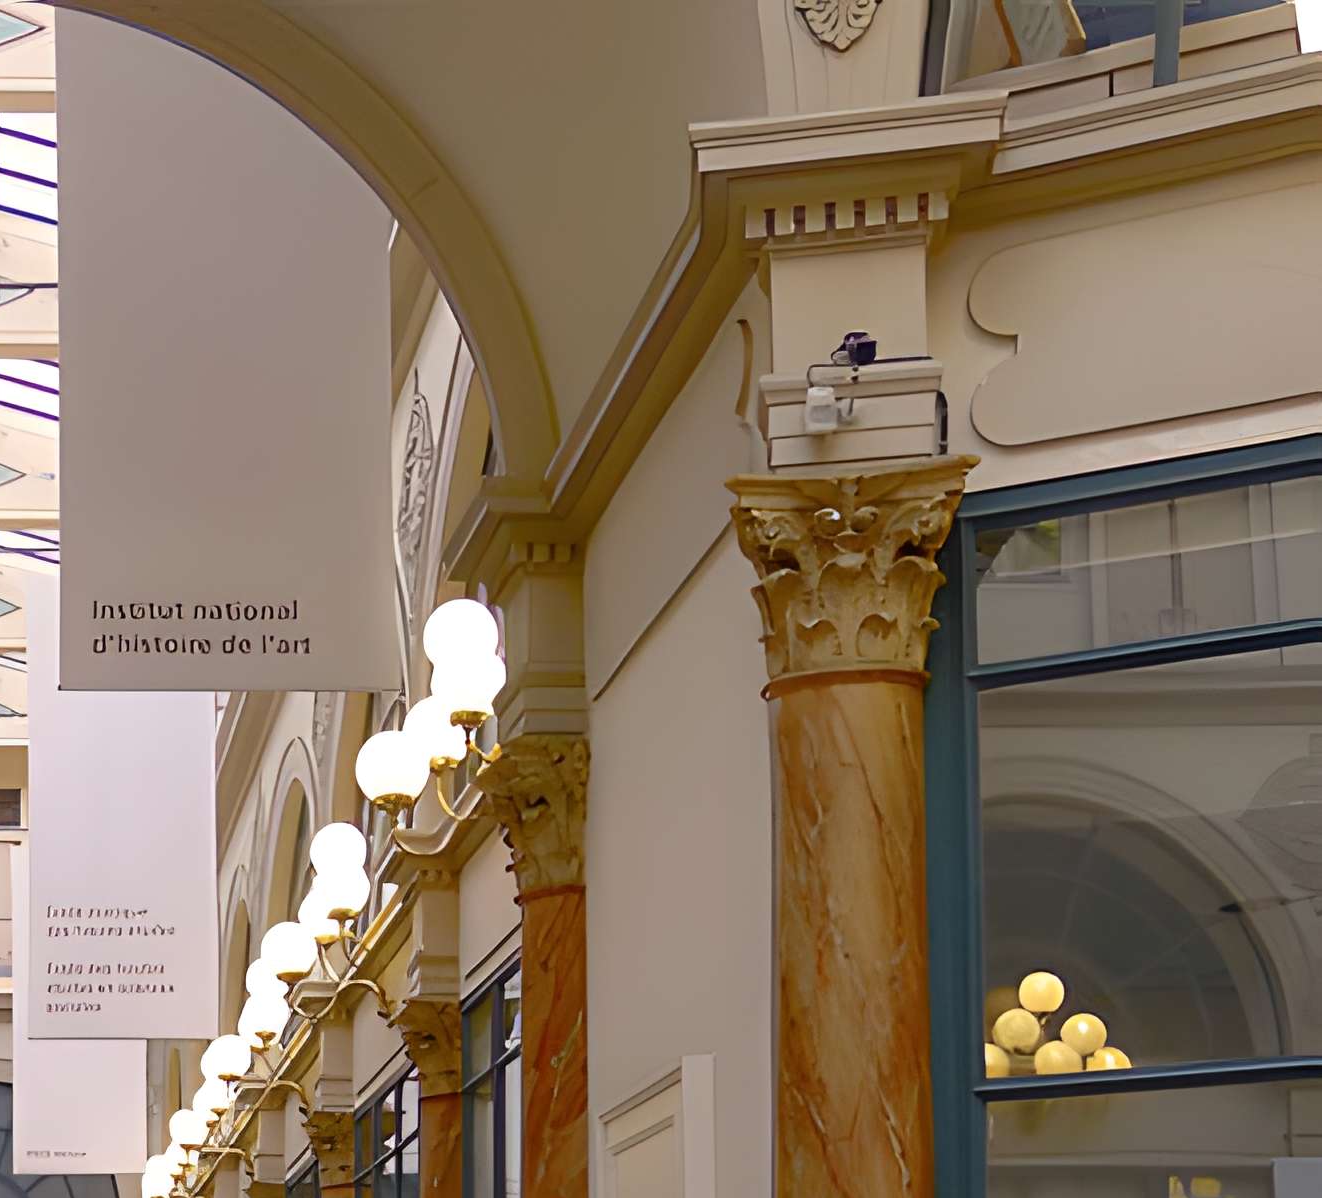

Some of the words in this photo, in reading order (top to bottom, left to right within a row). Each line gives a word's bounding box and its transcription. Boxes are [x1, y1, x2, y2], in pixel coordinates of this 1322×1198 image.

[93, 600, 183, 620] Institut
[193, 600, 298, 621] national
[93, 634, 212, 655] d'histoire
[222, 634, 251, 655] de
[262, 634, 311, 655] l'art
